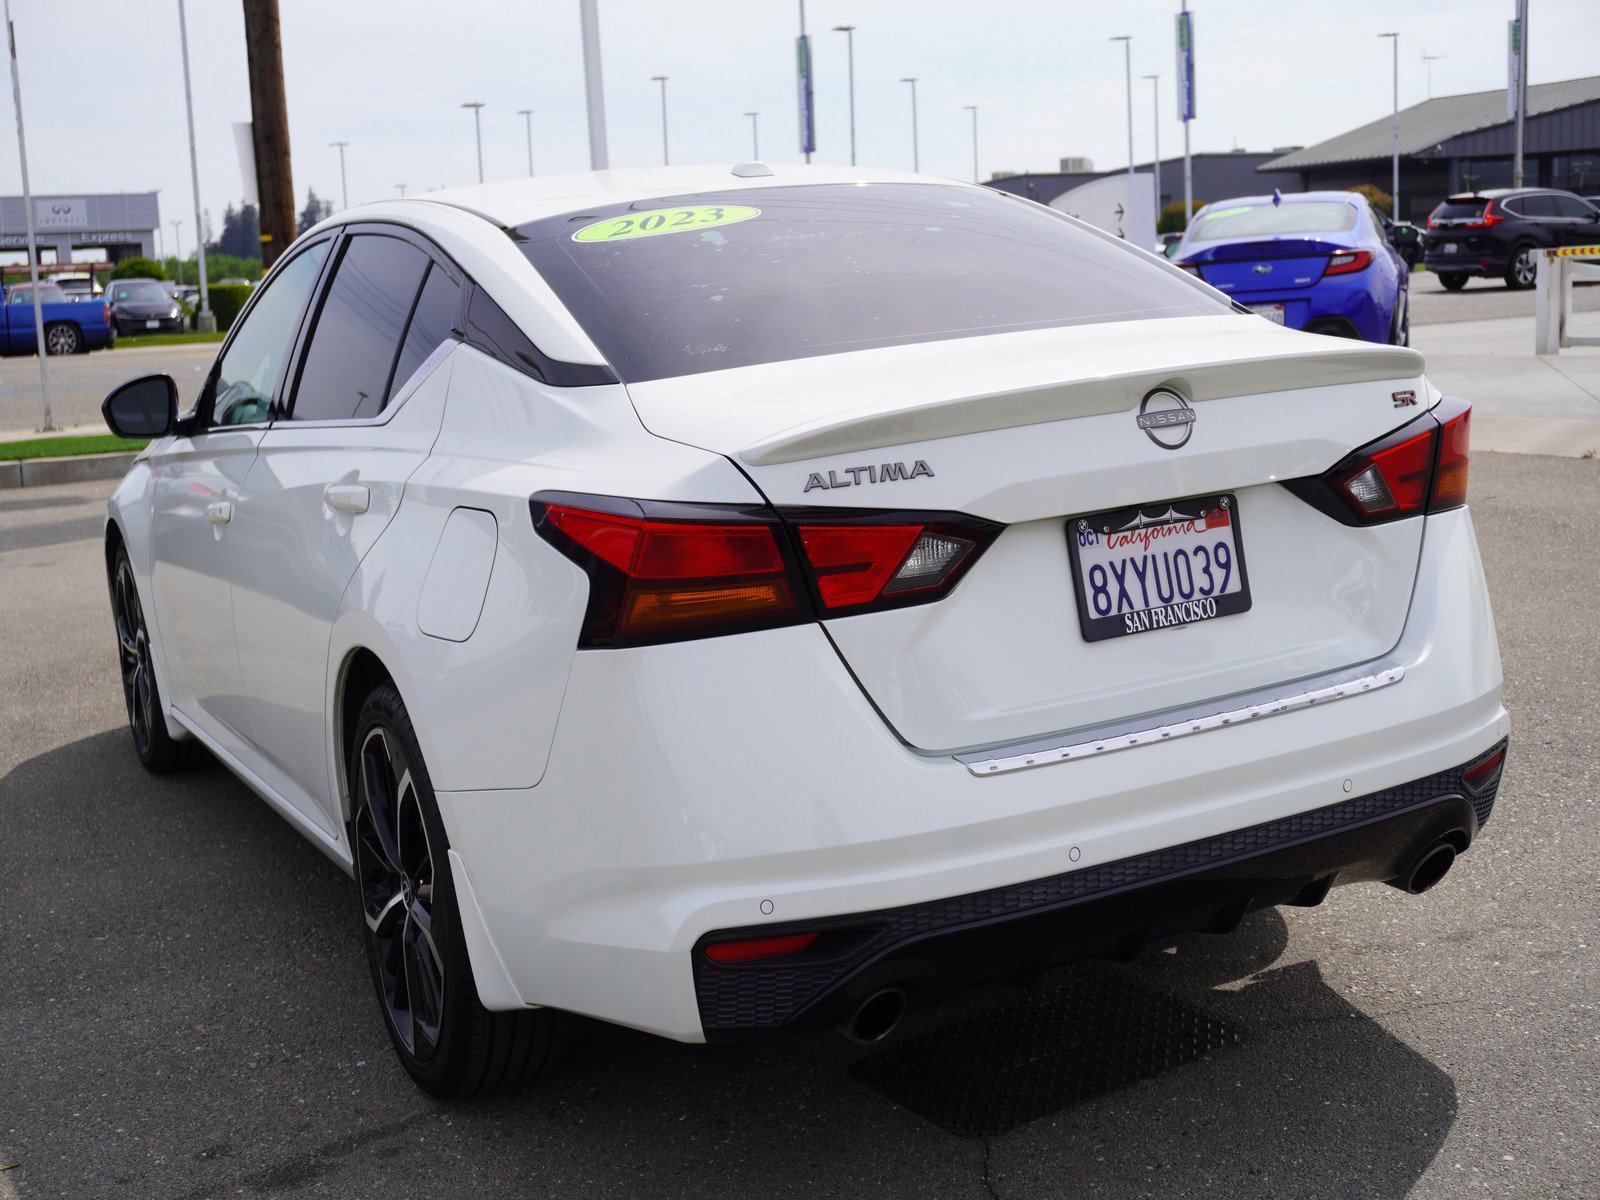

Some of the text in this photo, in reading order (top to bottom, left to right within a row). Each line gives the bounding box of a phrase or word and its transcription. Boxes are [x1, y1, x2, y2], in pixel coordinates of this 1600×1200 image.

[608, 207, 725, 237] 2023
[81, 232, 132, 245] Express
[1392, 390, 1418, 408] SR
[1139, 411, 1195, 426] NISSAN
[803, 460, 935, 492] ALTIMA
[1078, 529, 1100, 548] OCT
[1106, 520, 1207, 551] California
[1088, 541, 1232, 617] 8XYU039
[1124, 598, 1217, 633] SAN FRANCISCO
